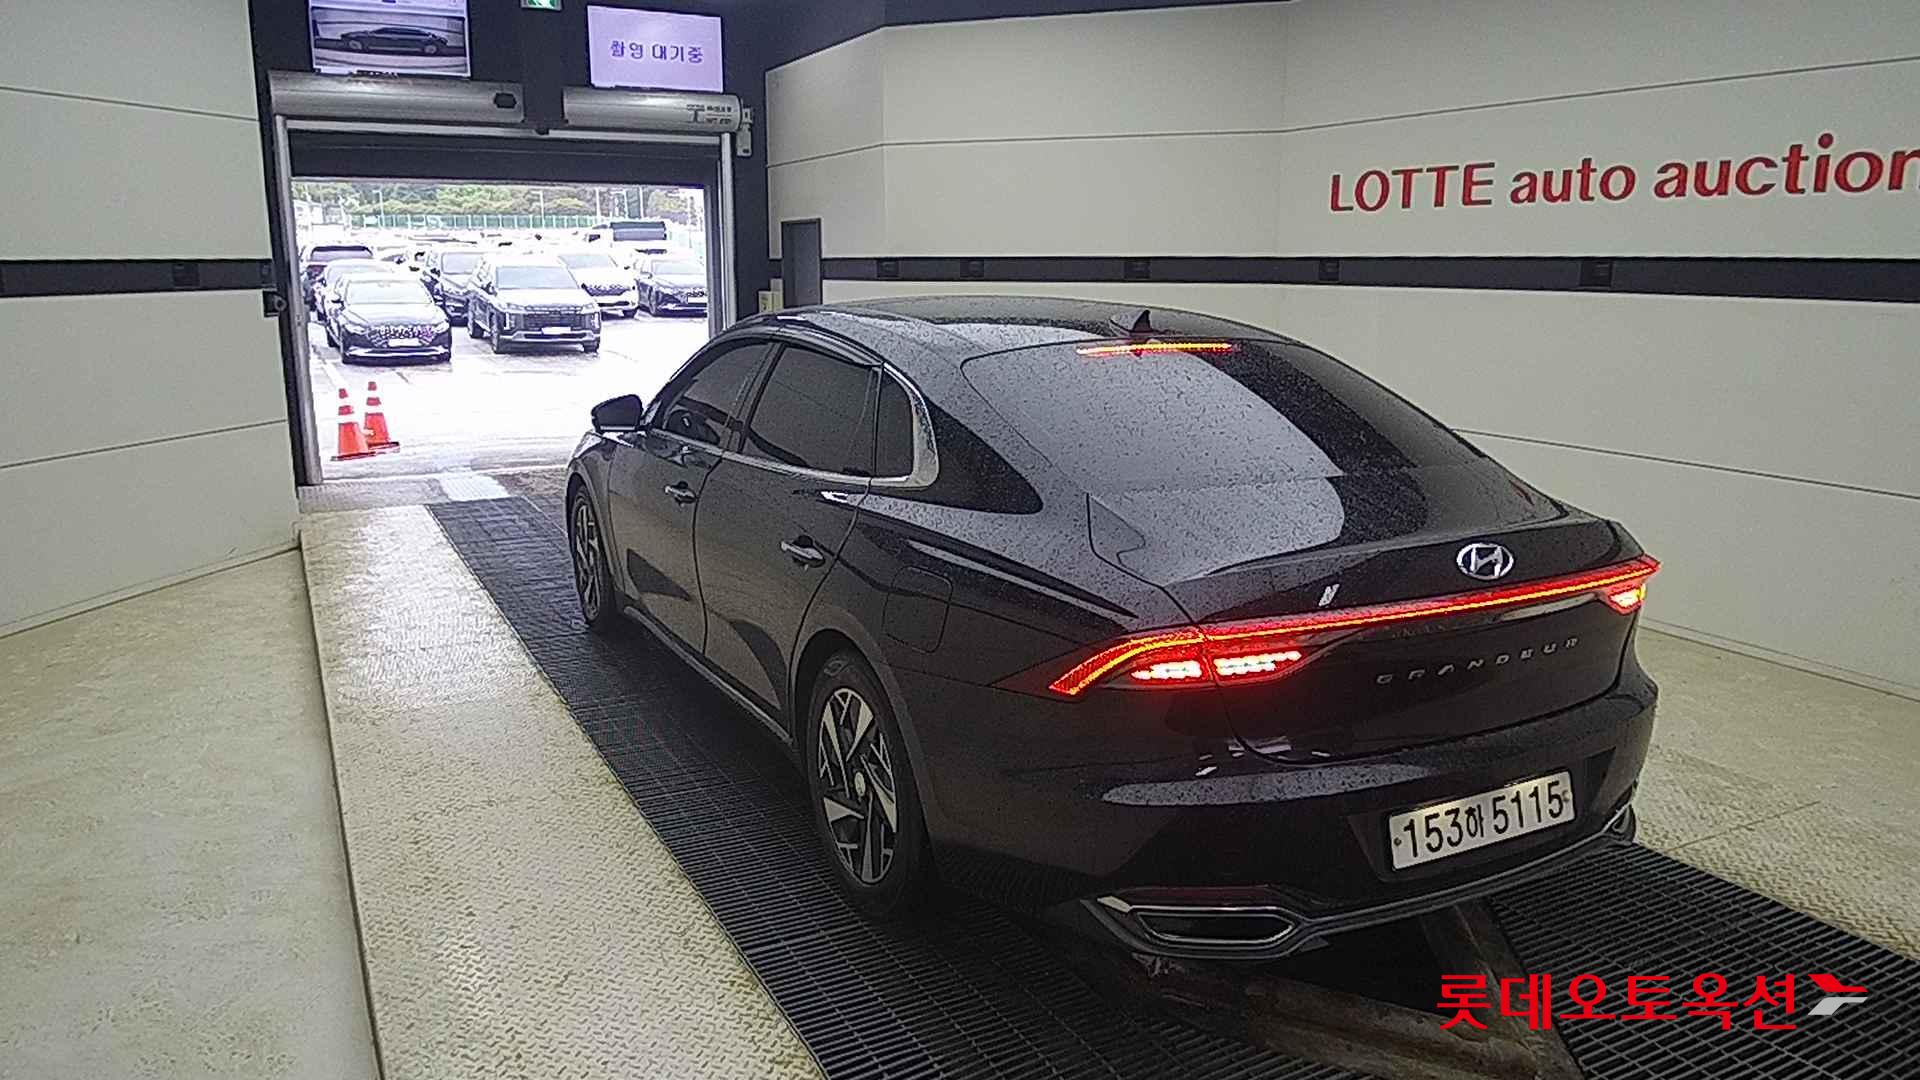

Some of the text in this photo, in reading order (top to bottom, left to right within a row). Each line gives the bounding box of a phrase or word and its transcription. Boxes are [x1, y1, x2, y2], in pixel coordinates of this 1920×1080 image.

[610, 40, 704, 64] 촬영 대기중
[1330, 162, 1495, 212] LOTTE
[1510, 157, 1637, 205] auto
[1376, 637, 1578, 684] GRANDEUR
